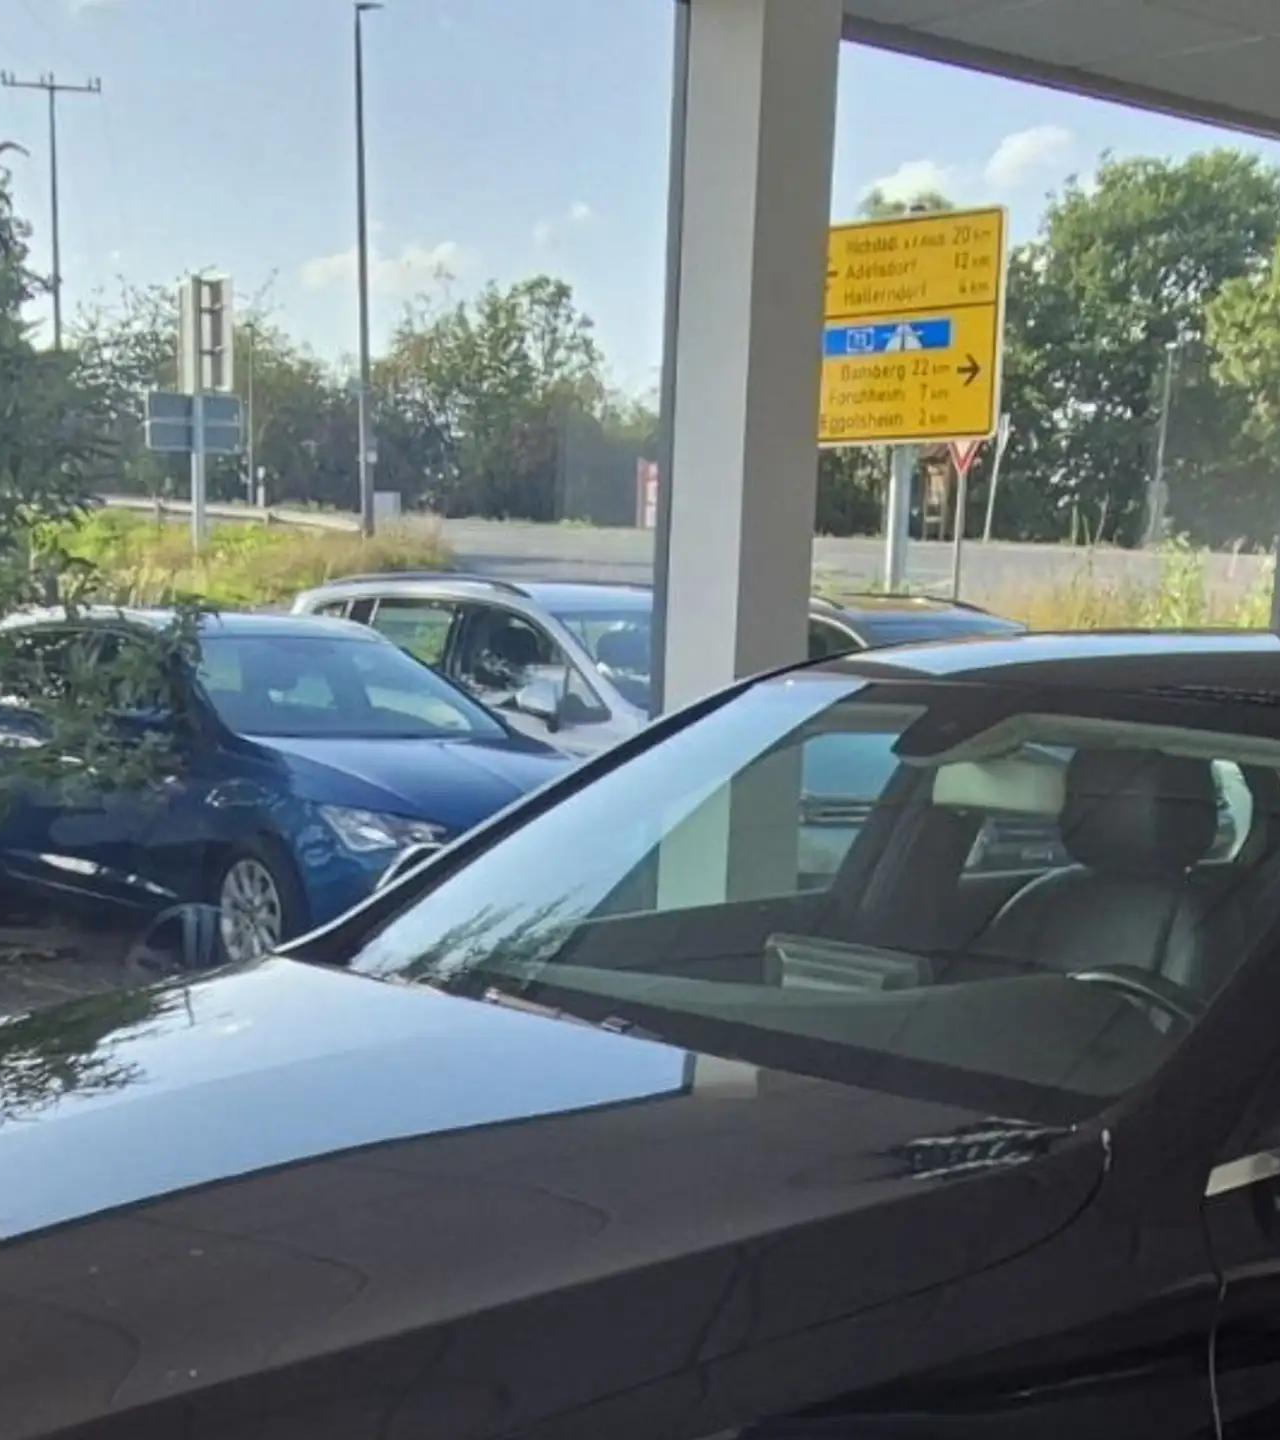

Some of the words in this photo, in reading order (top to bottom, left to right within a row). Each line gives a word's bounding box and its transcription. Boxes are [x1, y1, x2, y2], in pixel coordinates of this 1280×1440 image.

[952, 226, 970, 245] 20
[841, 363, 907, 382] Bamberg
[912, 358, 929, 376] 22
